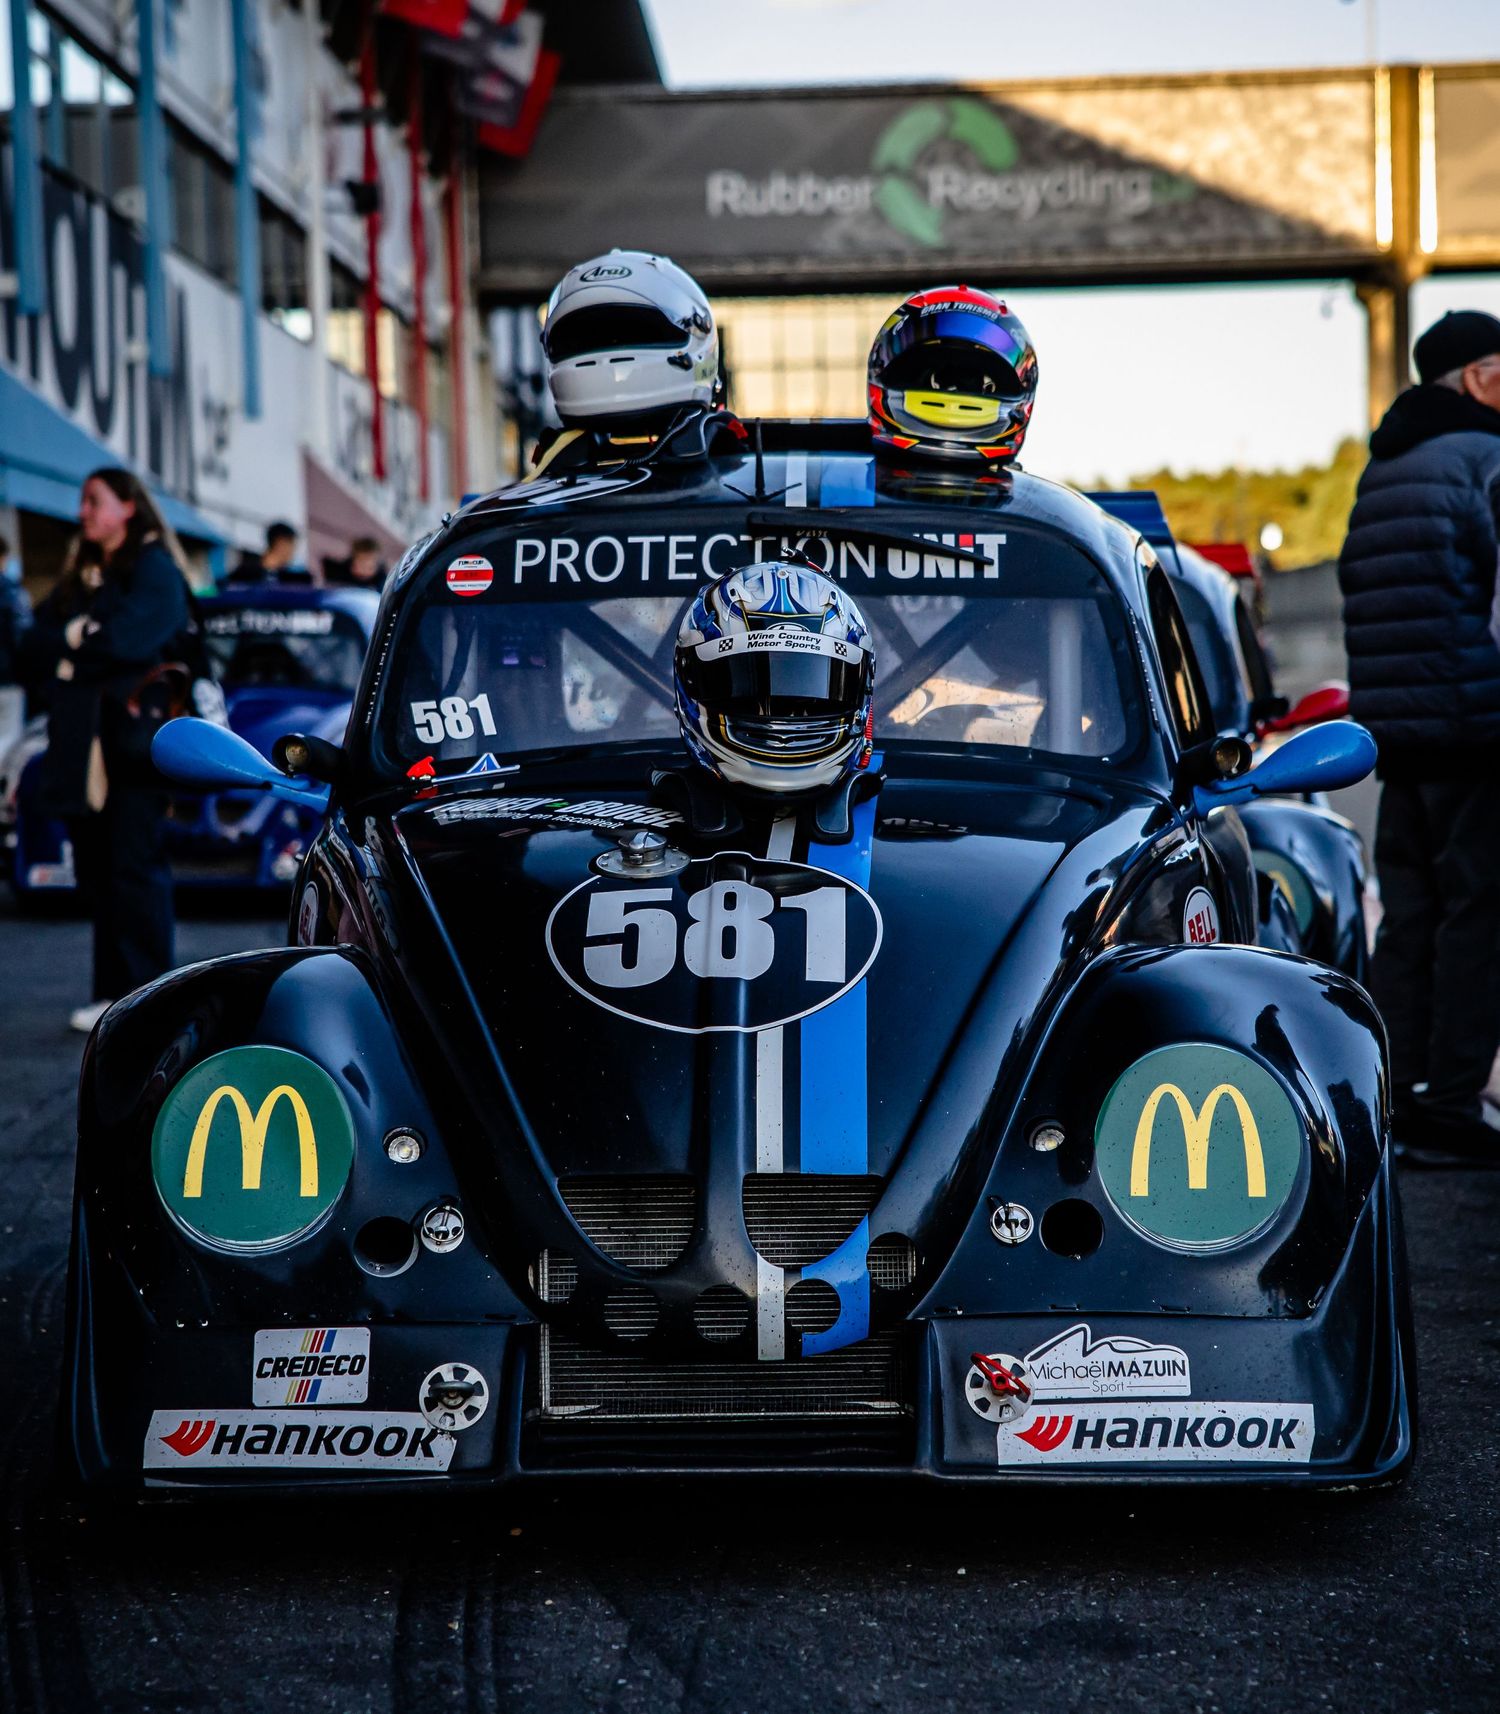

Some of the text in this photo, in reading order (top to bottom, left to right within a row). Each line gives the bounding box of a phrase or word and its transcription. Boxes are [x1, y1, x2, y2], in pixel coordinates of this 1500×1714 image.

[706, 169, 872, 218] Rubber
[928, 162, 1152, 222] Recycling
[921, 302, 951, 315] GRAN
[953, 302, 998, 319] TURISMO
[747, 640, 821, 651] Motor Sports
[748, 632, 821, 645] Wine Country
[410, 693, 497, 744] 581
[583, 880, 846, 988] 581
[1187, 906, 1217, 943] BELL
[256, 1354, 367, 1379] CREDECO
[1092, 1380, 1125, 1395] Sport
